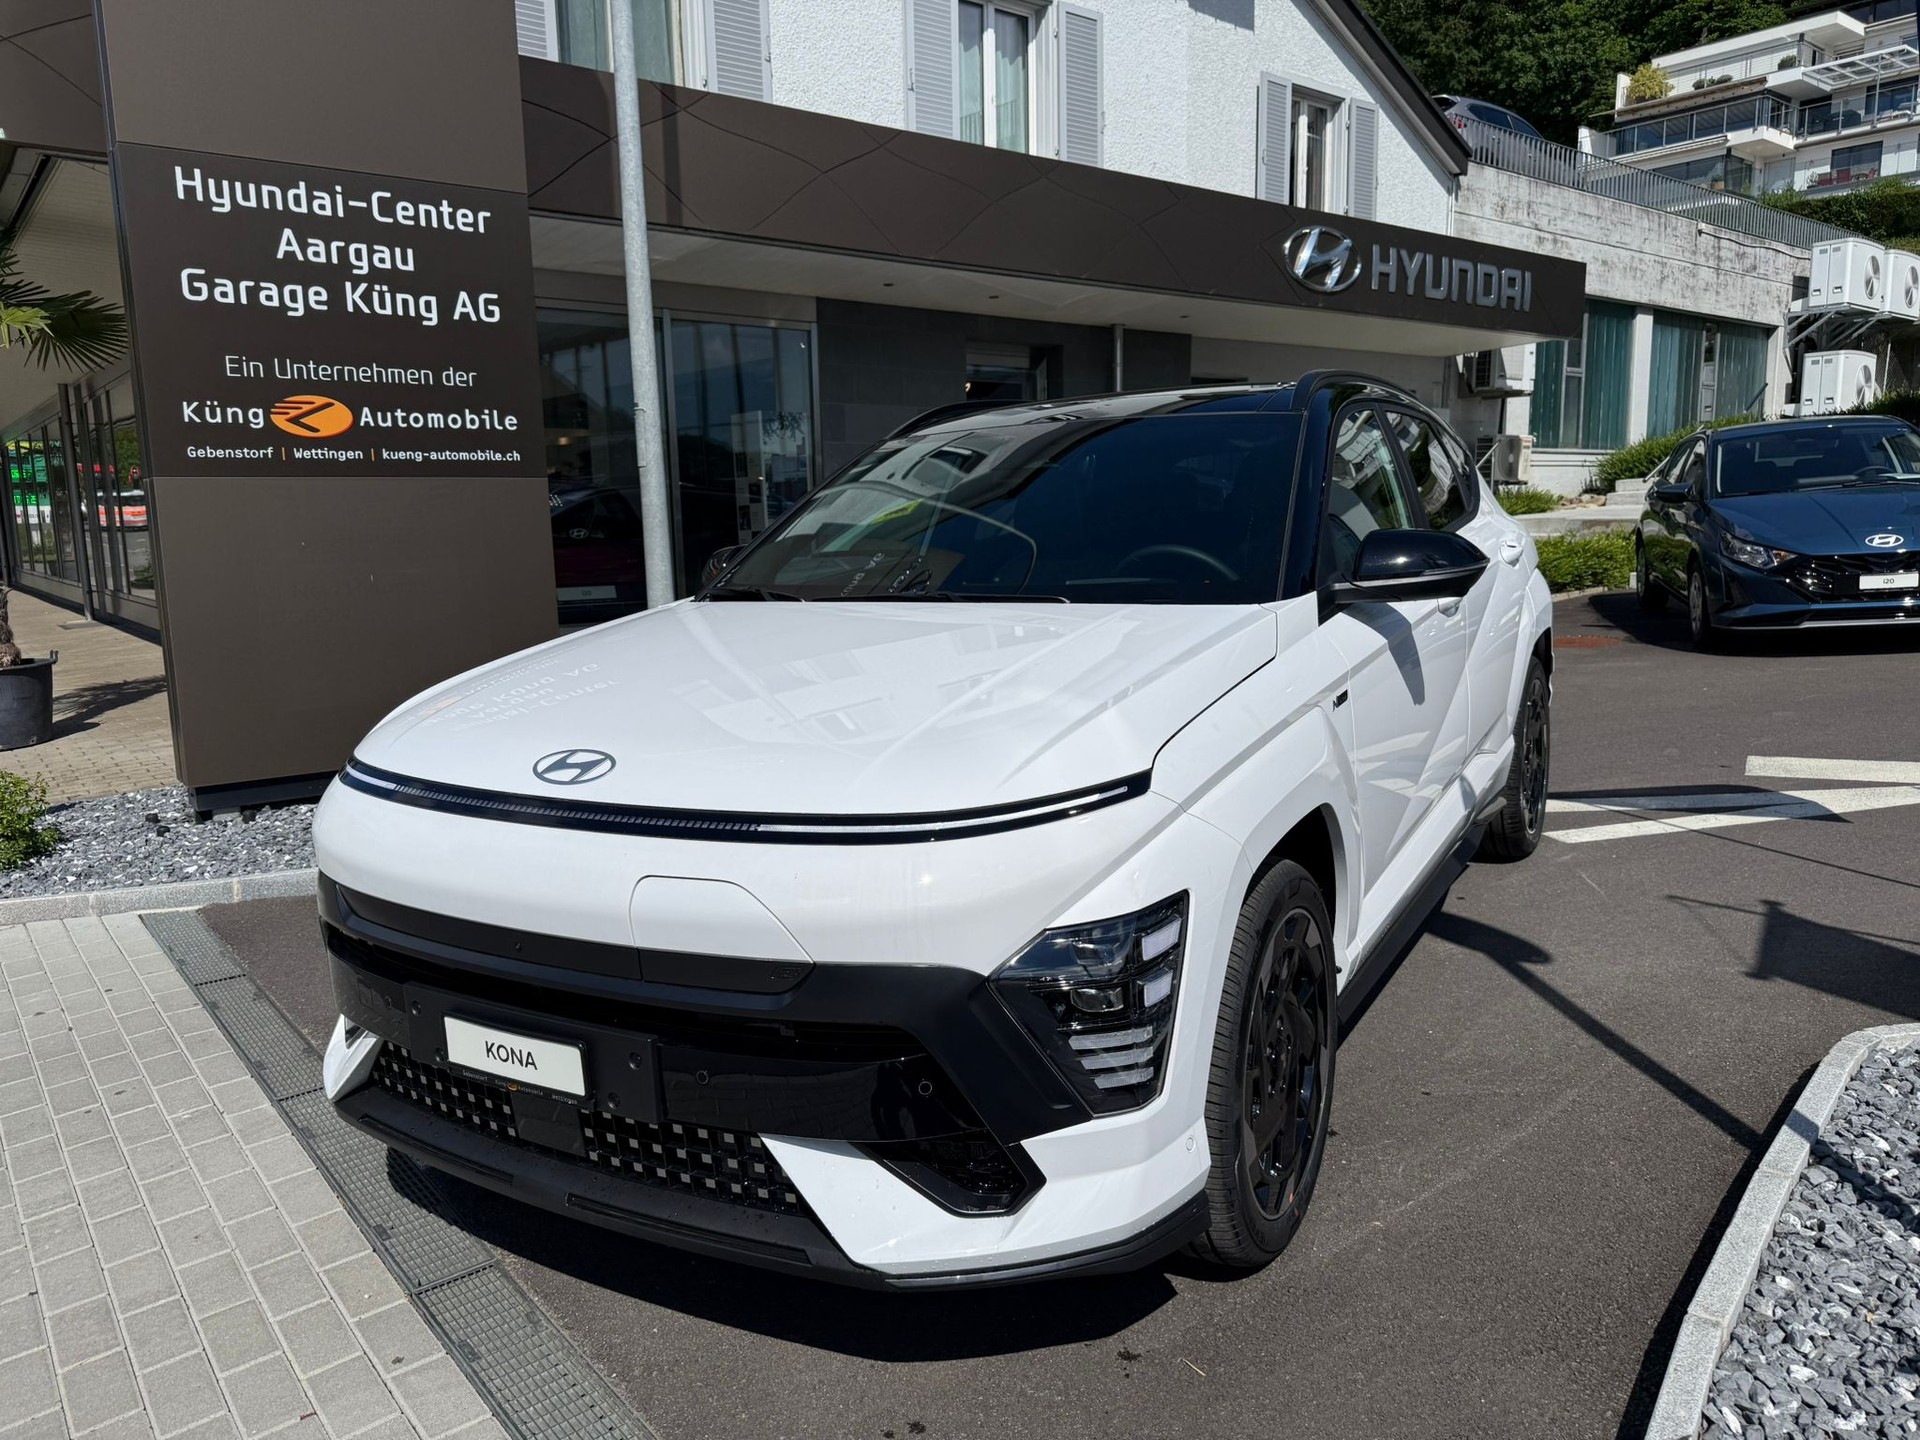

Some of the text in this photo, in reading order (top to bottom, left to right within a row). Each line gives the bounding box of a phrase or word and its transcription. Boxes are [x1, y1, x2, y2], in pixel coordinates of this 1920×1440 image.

[174, 165, 491, 234] Hyundai-Center
[276, 227, 415, 275] Aargau
[180, 268, 501, 326] Garage Küng AG
[1371, 243, 1532, 312] HYUNDAI
[225, 355, 477, 387] Ein Unternehmen der
[182, 400, 518, 431] Küng Automobile
[186, 445, 521, 462] Gebenstorf Wettingen kueng-automobile.ch
[484, 1040, 538, 1071] KONA
